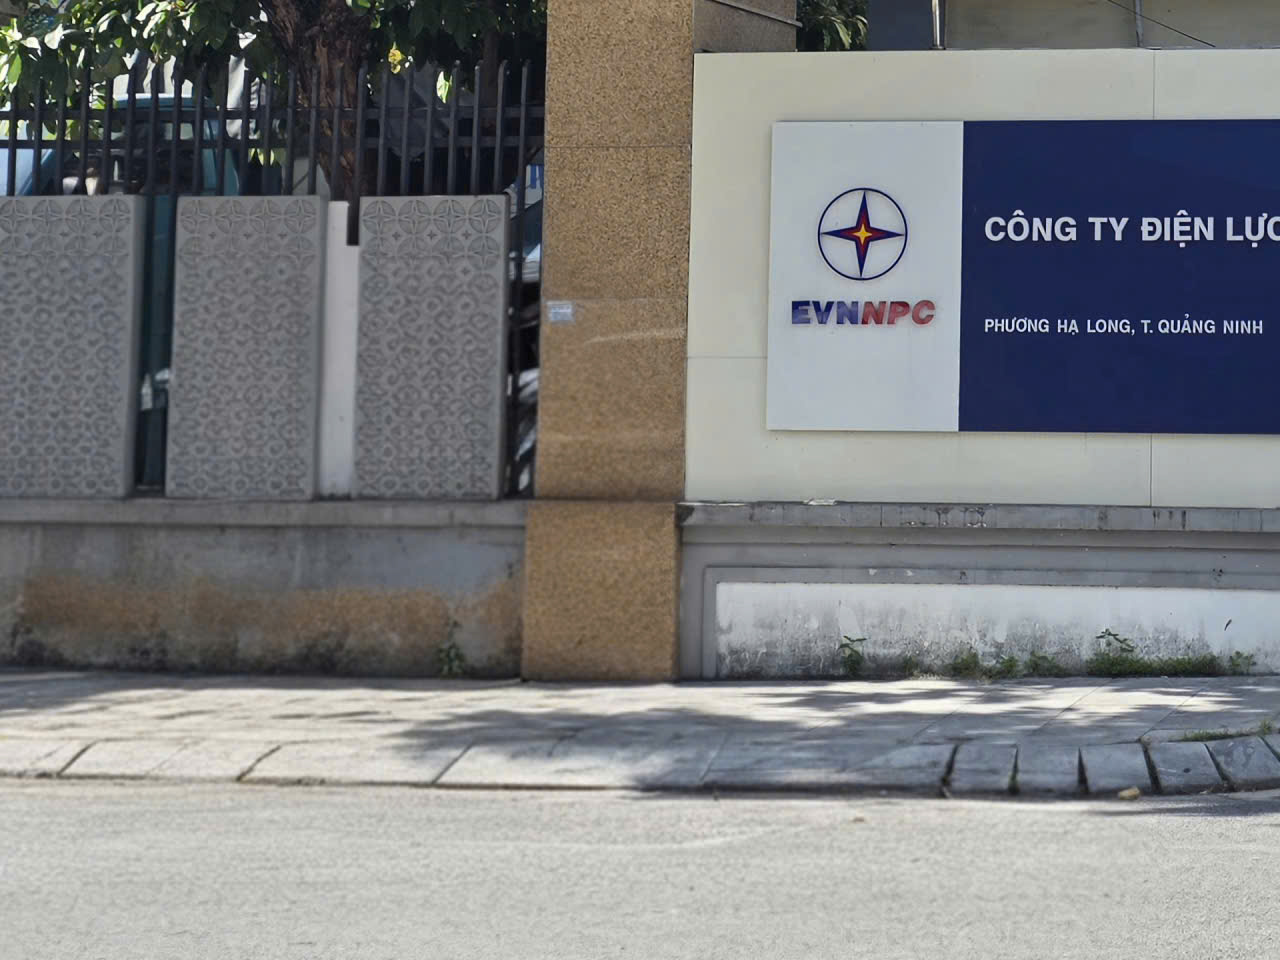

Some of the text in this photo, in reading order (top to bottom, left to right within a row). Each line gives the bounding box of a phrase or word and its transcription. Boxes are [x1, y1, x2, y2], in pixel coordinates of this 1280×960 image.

[985, 208, 1077, 242] CÔNG
[1087, 216, 1129, 242] TY
[1140, 209, 1214, 248] ĐIỆN
[791, 300, 936, 325] EVNNPC
[1057, 318, 1080, 338] HẠ
[1086, 318, 1135, 337] LONG,
[1140, 318, 1155, 334] T.
[1157, 312, 1216, 335] QUẢNG
[1223, 318, 1263, 335] NINH
